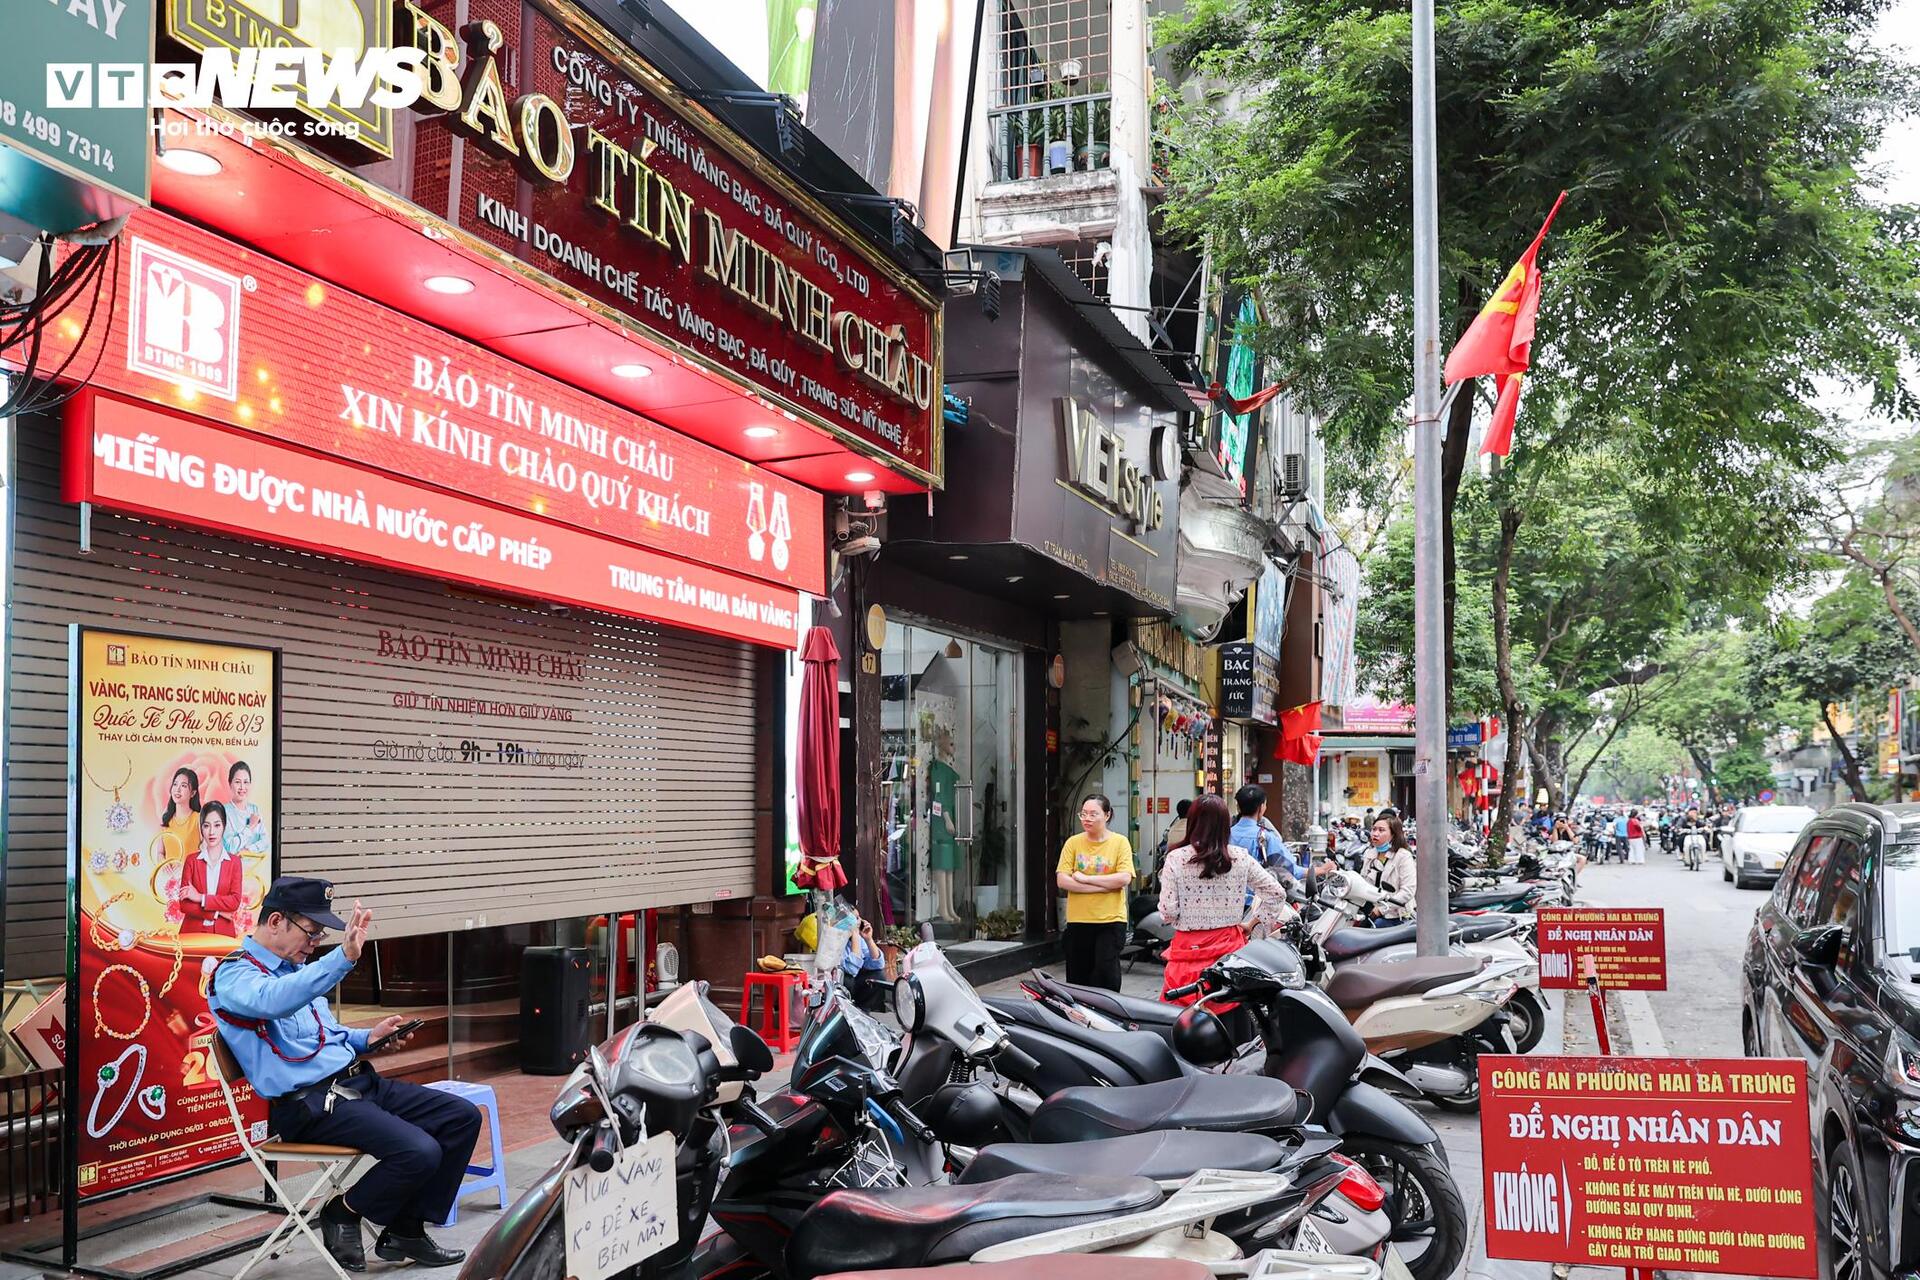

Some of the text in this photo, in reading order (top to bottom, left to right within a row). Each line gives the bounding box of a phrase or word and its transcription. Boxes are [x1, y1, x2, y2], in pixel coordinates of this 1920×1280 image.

[22, 110, 115, 173] 499 7314
[553, 45, 612, 106] CÔNG
[616, 89, 639, 125] TY
[644, 112, 688, 164] TNHH
[690, 146, 730, 194] VÀNG
[732, 180, 761, 216] BẠC
[764, 203, 784, 234] ĐÁ
[846, 265, 870, 298] LTD)
[405, 1, 932, 411] BẢO TÍN MINH CHÂU
[478, 192, 528, 242] KINH
[533, 223, 600, 281] DOANH
[643, 286, 673, 320] TÁC
[677, 302, 715, 343] VÀNG
[800, 375, 838, 411] TRANG
[412, 355, 674, 482] BẢO TÍN MINH CHÂU
[339, 384, 711, 537] XIN KÍNH CHÀO QUÝ KHÁCH
[213, 463, 305, 513] ĐƯỢC
[312, 488, 371, 529] NHÀ
[376, 504, 448, 548] NƯỚC
[452, 521, 496, 558] CẤP
[500, 537, 552, 571] PHÉP
[608, 565, 664, 599] TRUNG
[666, 576, 697, 607] TÂM
[700, 587, 730, 614] MUA
[732, 593, 757, 621] BÁN
[759, 603, 793, 630] VÀNG
[131, 651, 255, 675] BẢO TÍN MINH CHÂU
[377, 625, 430, 662] BẢO
[433, 632, 472, 668] TÍN
[476, 644, 532, 676] MINH
[1224, 659, 1250, 674] BẠC
[89, 678, 267, 708] VÀNG, TRANG SỨC MỪNG NGÀY
[1223, 677, 1252, 687] TRANG
[93, 704, 137, 730] Quốc
[236, 713, 265, 736] 8/3
[423, 693, 443, 711] TÍN
[447, 697, 486, 718] NHIỆM
[490, 702, 516, 717] HƠN
[543, 705, 573, 722] VÀNG
[98, 733, 123, 742] THAY
[460, 740, 481, 762] 9h
[496, 742, 524, 763] 19h
[1565, 929, 1592, 943] NGHỊ
[1594, 927, 1627, 941] NHÂN
[1629, 927, 1653, 942] DÂN
[1541, 949, 1567, 977] KHÔNG
[1491, 1068, 1796, 1094] CÔNG AN HAI BÀ TRƯNG
[177, 1095, 199, 1106] CÙNG
[1509, 1101, 1782, 1149] ĐỀ NGHỊ NHÂN DÂN
[108, 1140, 128, 1152] THỜI
[128, 1137, 149, 1149] GIAN
[148, 1133, 159, 1144] ÁP
[1618, 1156, 1626, 1172] Ô
[1628, 1156, 1642, 1173] TÔ
[1644, 1157, 1670, 1174] TRÊN
[1673, 1158, 1686, 1174] HÈ
[1493, 1161, 1560, 1234] KHÔNG
[1585, 1180, 1620, 1197] KHÔNG
[1638, 1184, 1650, 1198] XE
[1653, 1183, 1675, 1199] MÁY
[1677, 1184, 1704, 1200] TRÊN
[1774, 1187, 1802, 1205] LÒNG
[1585, 1199, 1621, 1215] ĐƯỜNG
[1623, 1201, 1641, 1216] SAI
[1643, 1203, 1663, 1218] QUY
[1587, 1223, 1622, 1240] KHÔNG
[1625, 1222, 1643, 1241] XẾP
[1646, 1226, 1674, 1243] HÀNG
[1677, 1227, 1706, 1245] ĐỨNG
[1738, 1230, 1765, 1248] LÒNG
[1768, 1232, 1806, 1250] ĐƯỜNG
[1588, 1242, 1608, 1257] GÂY
[1610, 1241, 1631, 1259] CẢN
[1656, 1247, 1682, 1262] GIAO
[1684, 1246, 1720, 1264] THÔNG
